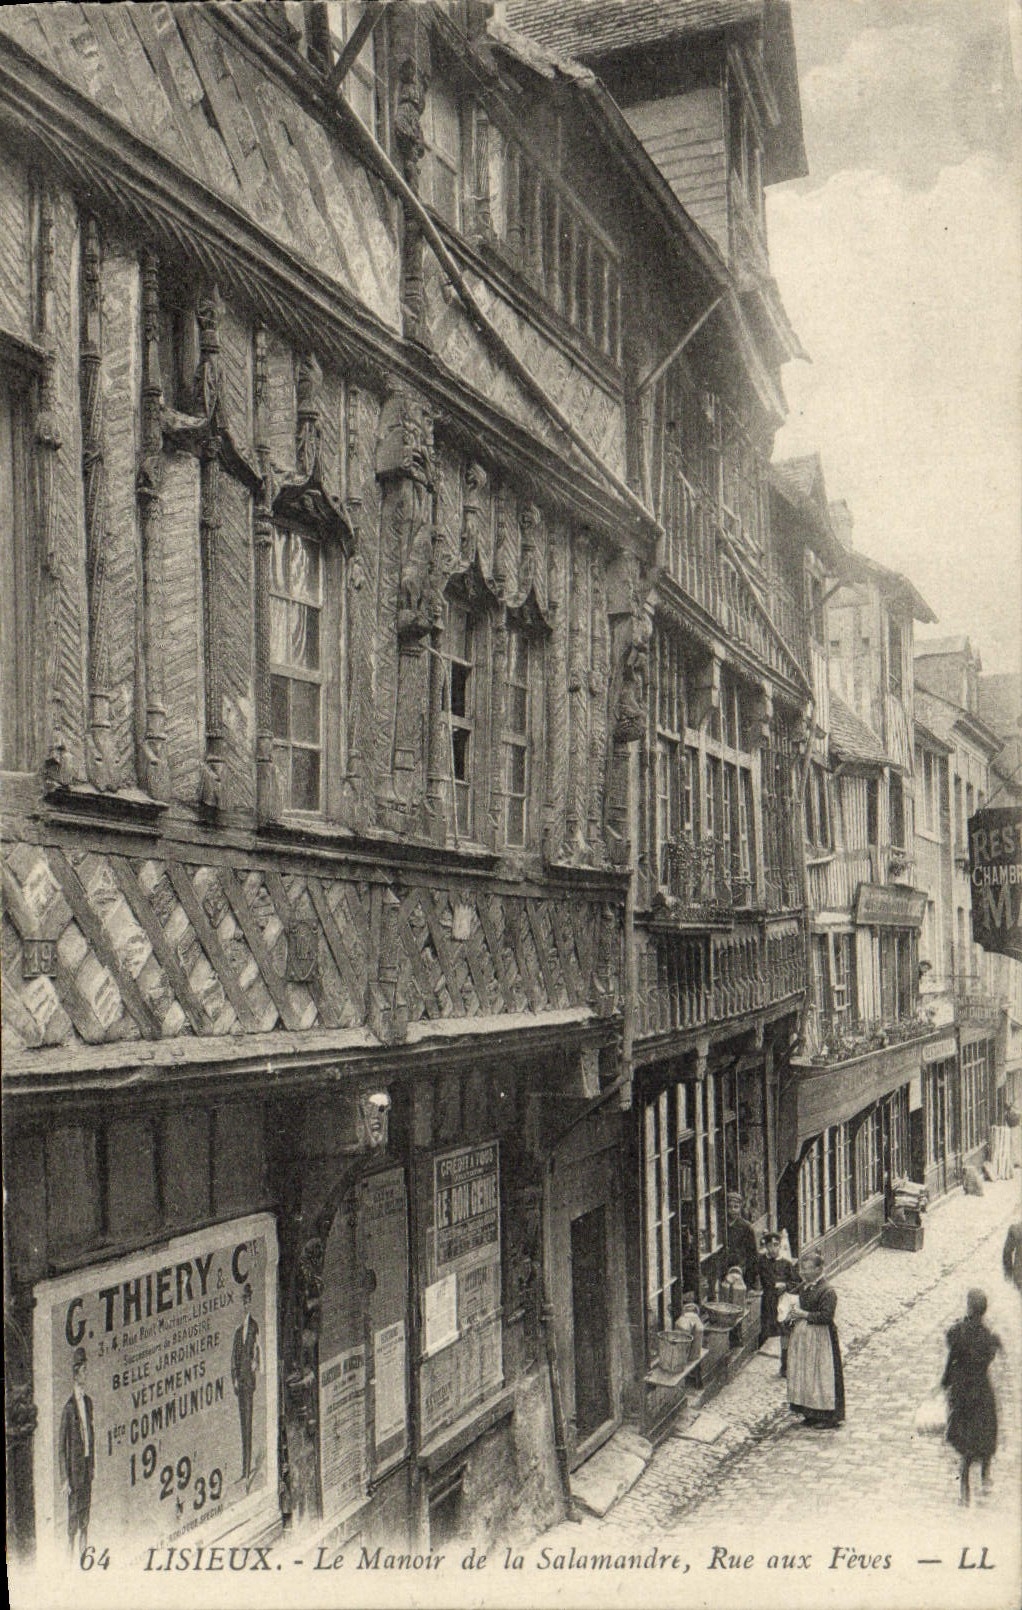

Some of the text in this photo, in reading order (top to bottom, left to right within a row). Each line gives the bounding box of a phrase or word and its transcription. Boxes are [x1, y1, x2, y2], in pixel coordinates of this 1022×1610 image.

[98, 1252, 215, 1333] THIERY
[216, 1268, 226, 1290] &
[192, 1291, 234, 1319] LISIEUX
[112, 1361, 150, 1391] BELLE
[130, 1376, 224, 1445] COMMUNION
